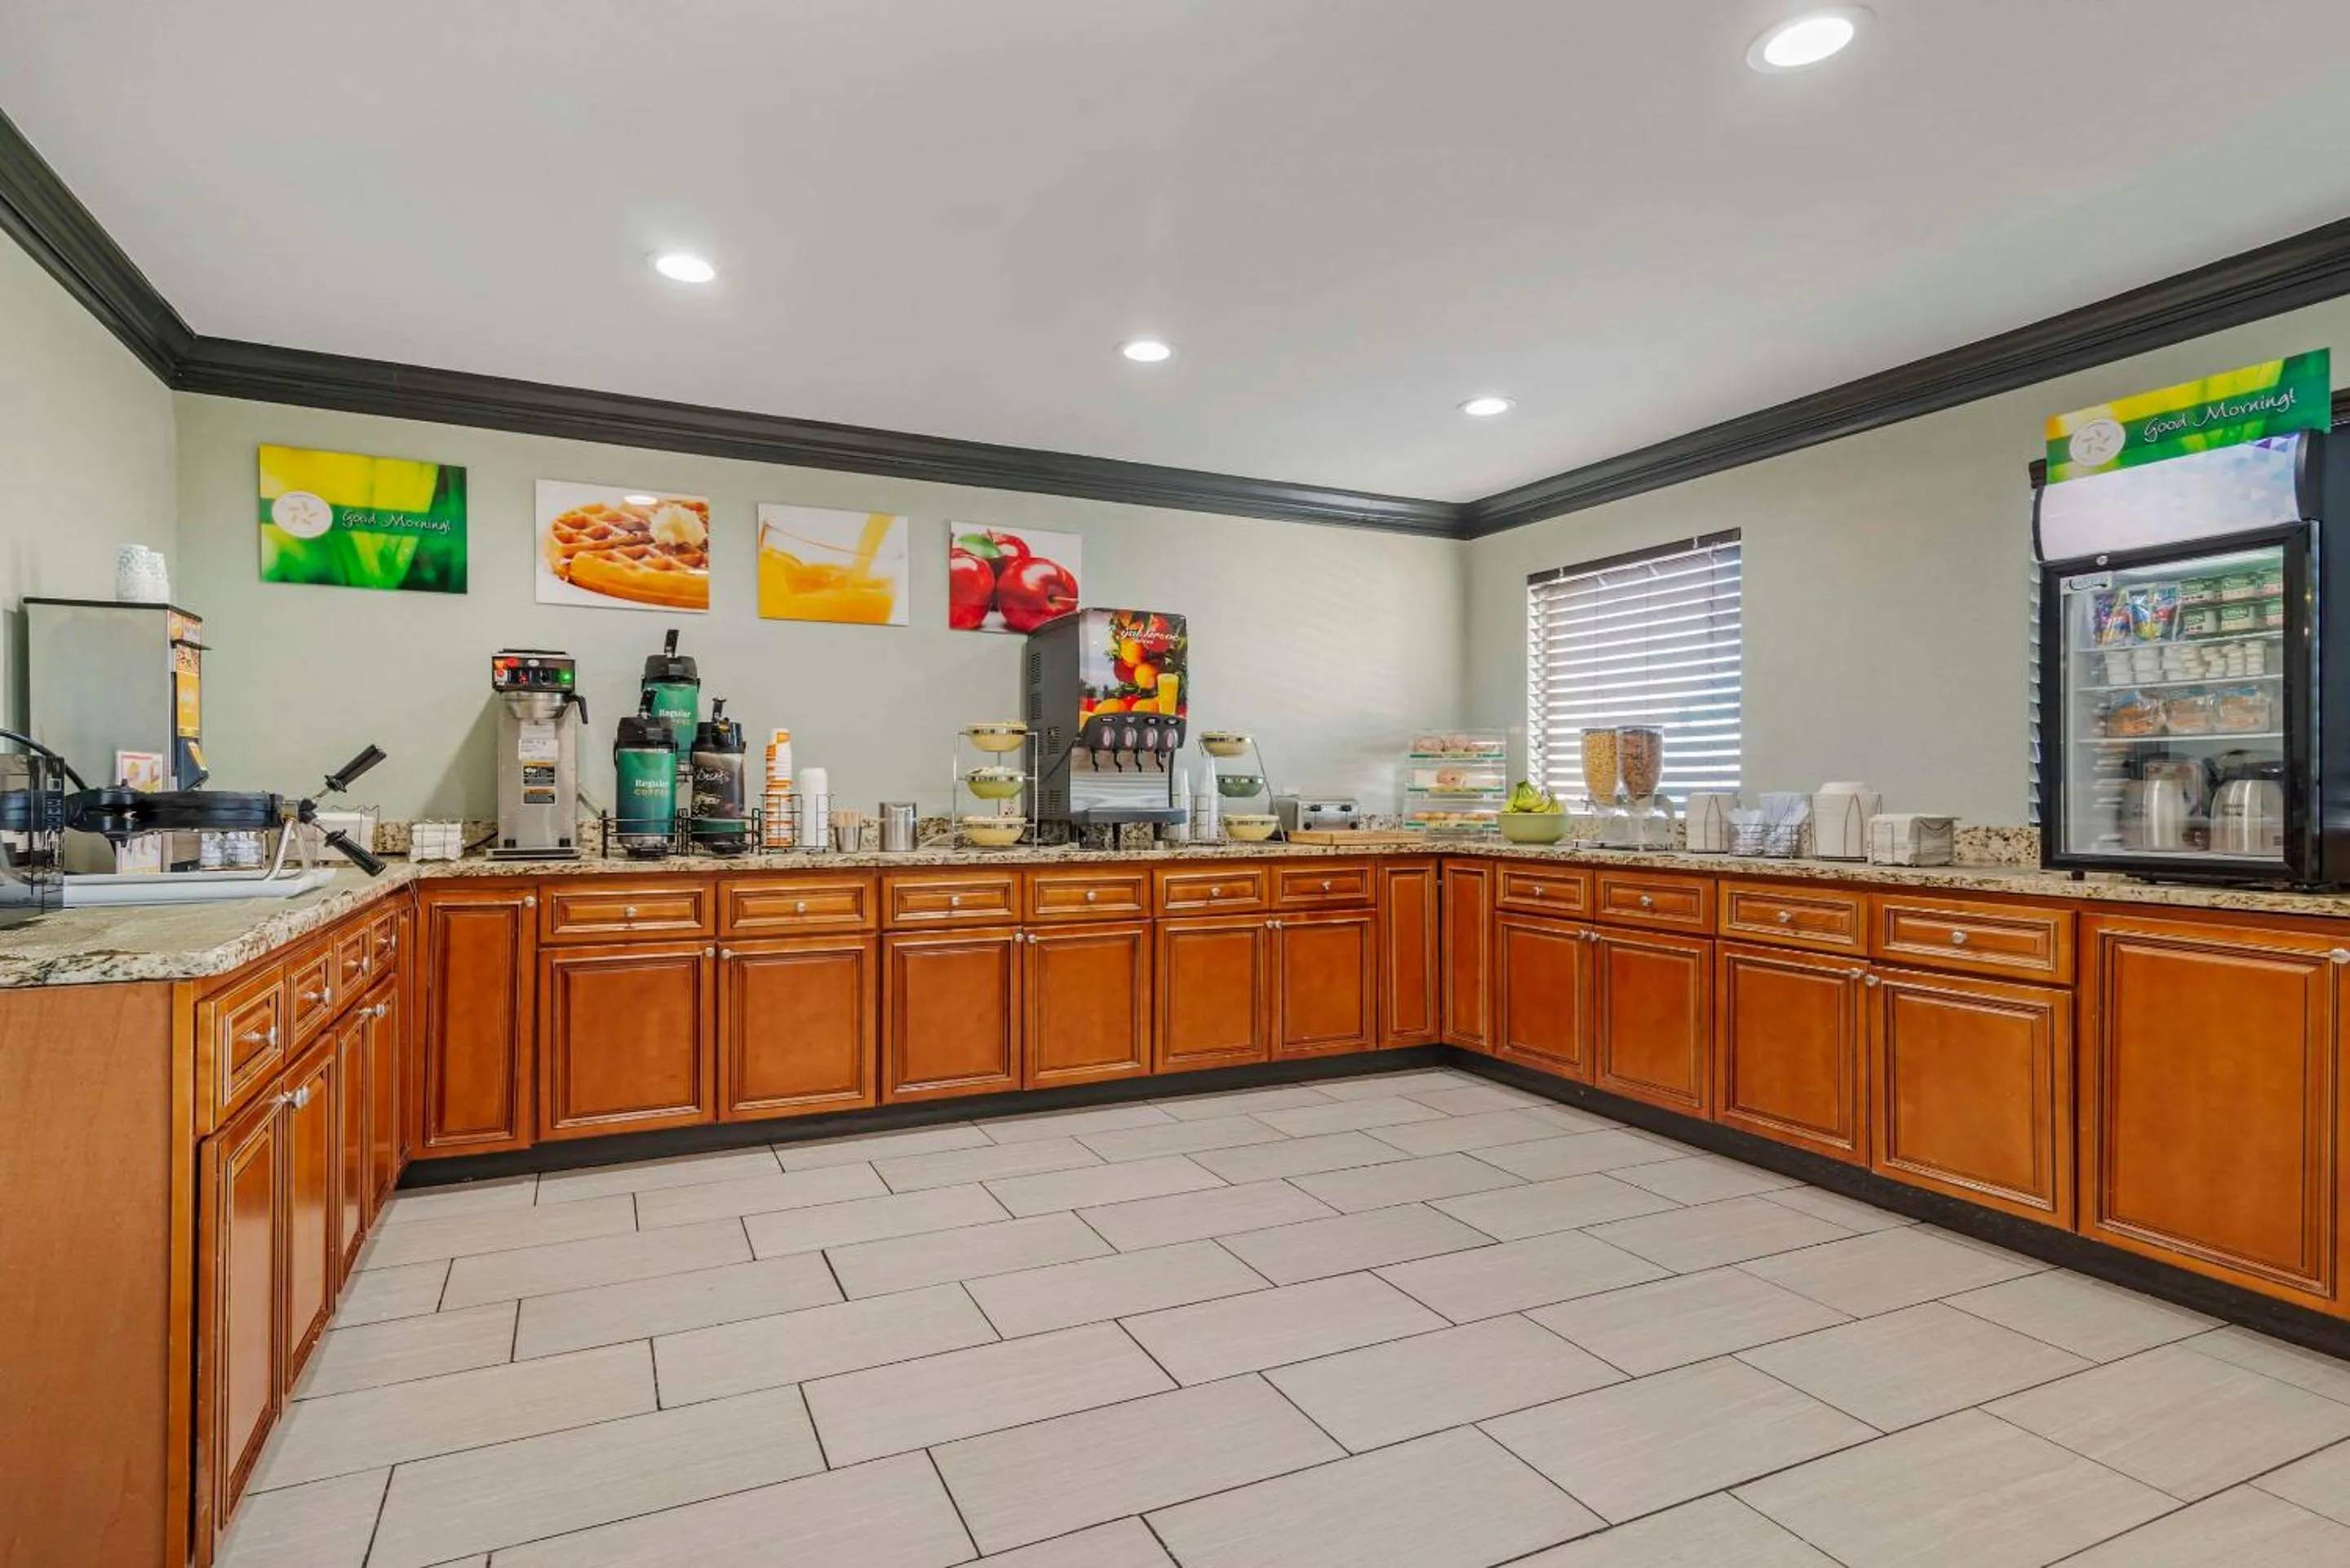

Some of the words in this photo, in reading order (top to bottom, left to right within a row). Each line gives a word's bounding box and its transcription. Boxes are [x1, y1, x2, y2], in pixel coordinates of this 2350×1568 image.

[2144, 414, 2188, 443] Good
[2192, 388, 2297, 427] Morning!
[342, 510, 376, 528] Good
[380, 513, 450, 534] Morning!
[658, 708, 692, 719] Regular
